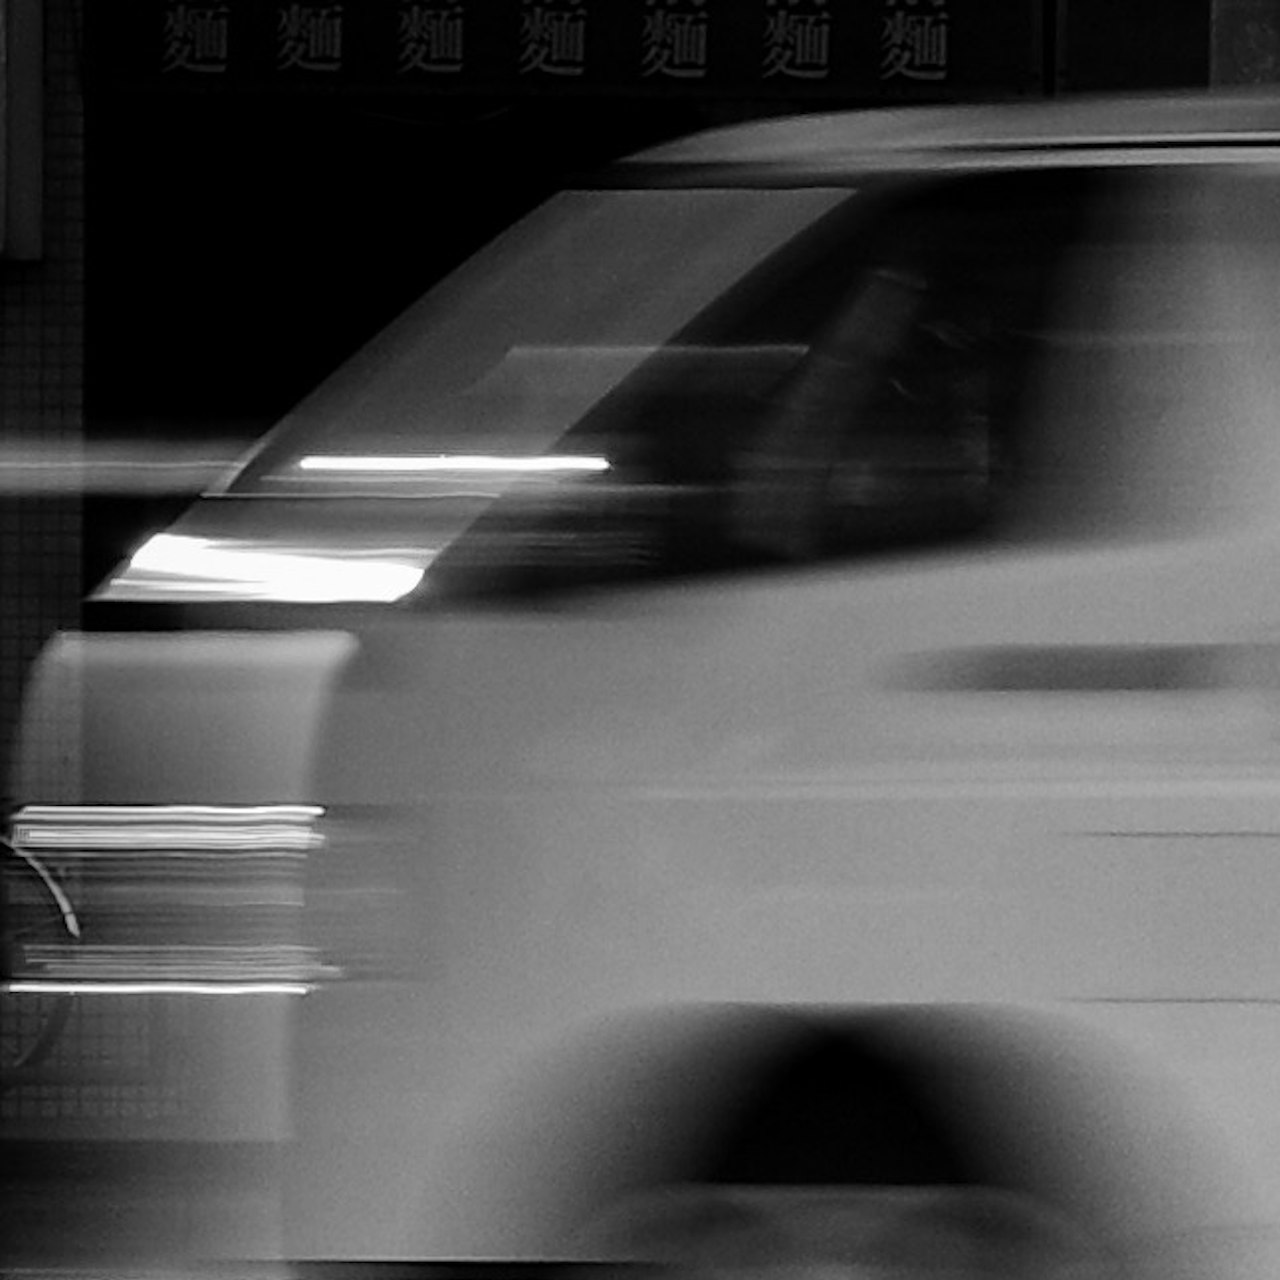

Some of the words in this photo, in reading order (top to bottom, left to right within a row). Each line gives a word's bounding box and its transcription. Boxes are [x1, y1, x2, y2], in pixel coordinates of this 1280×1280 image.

[397, 0, 464, 73] 麵
[518, 0, 586, 75] 麵
[640, 0, 708, 79] 麵
[762, 0, 831, 80] 麵
[880, 0, 949, 81] 麵
